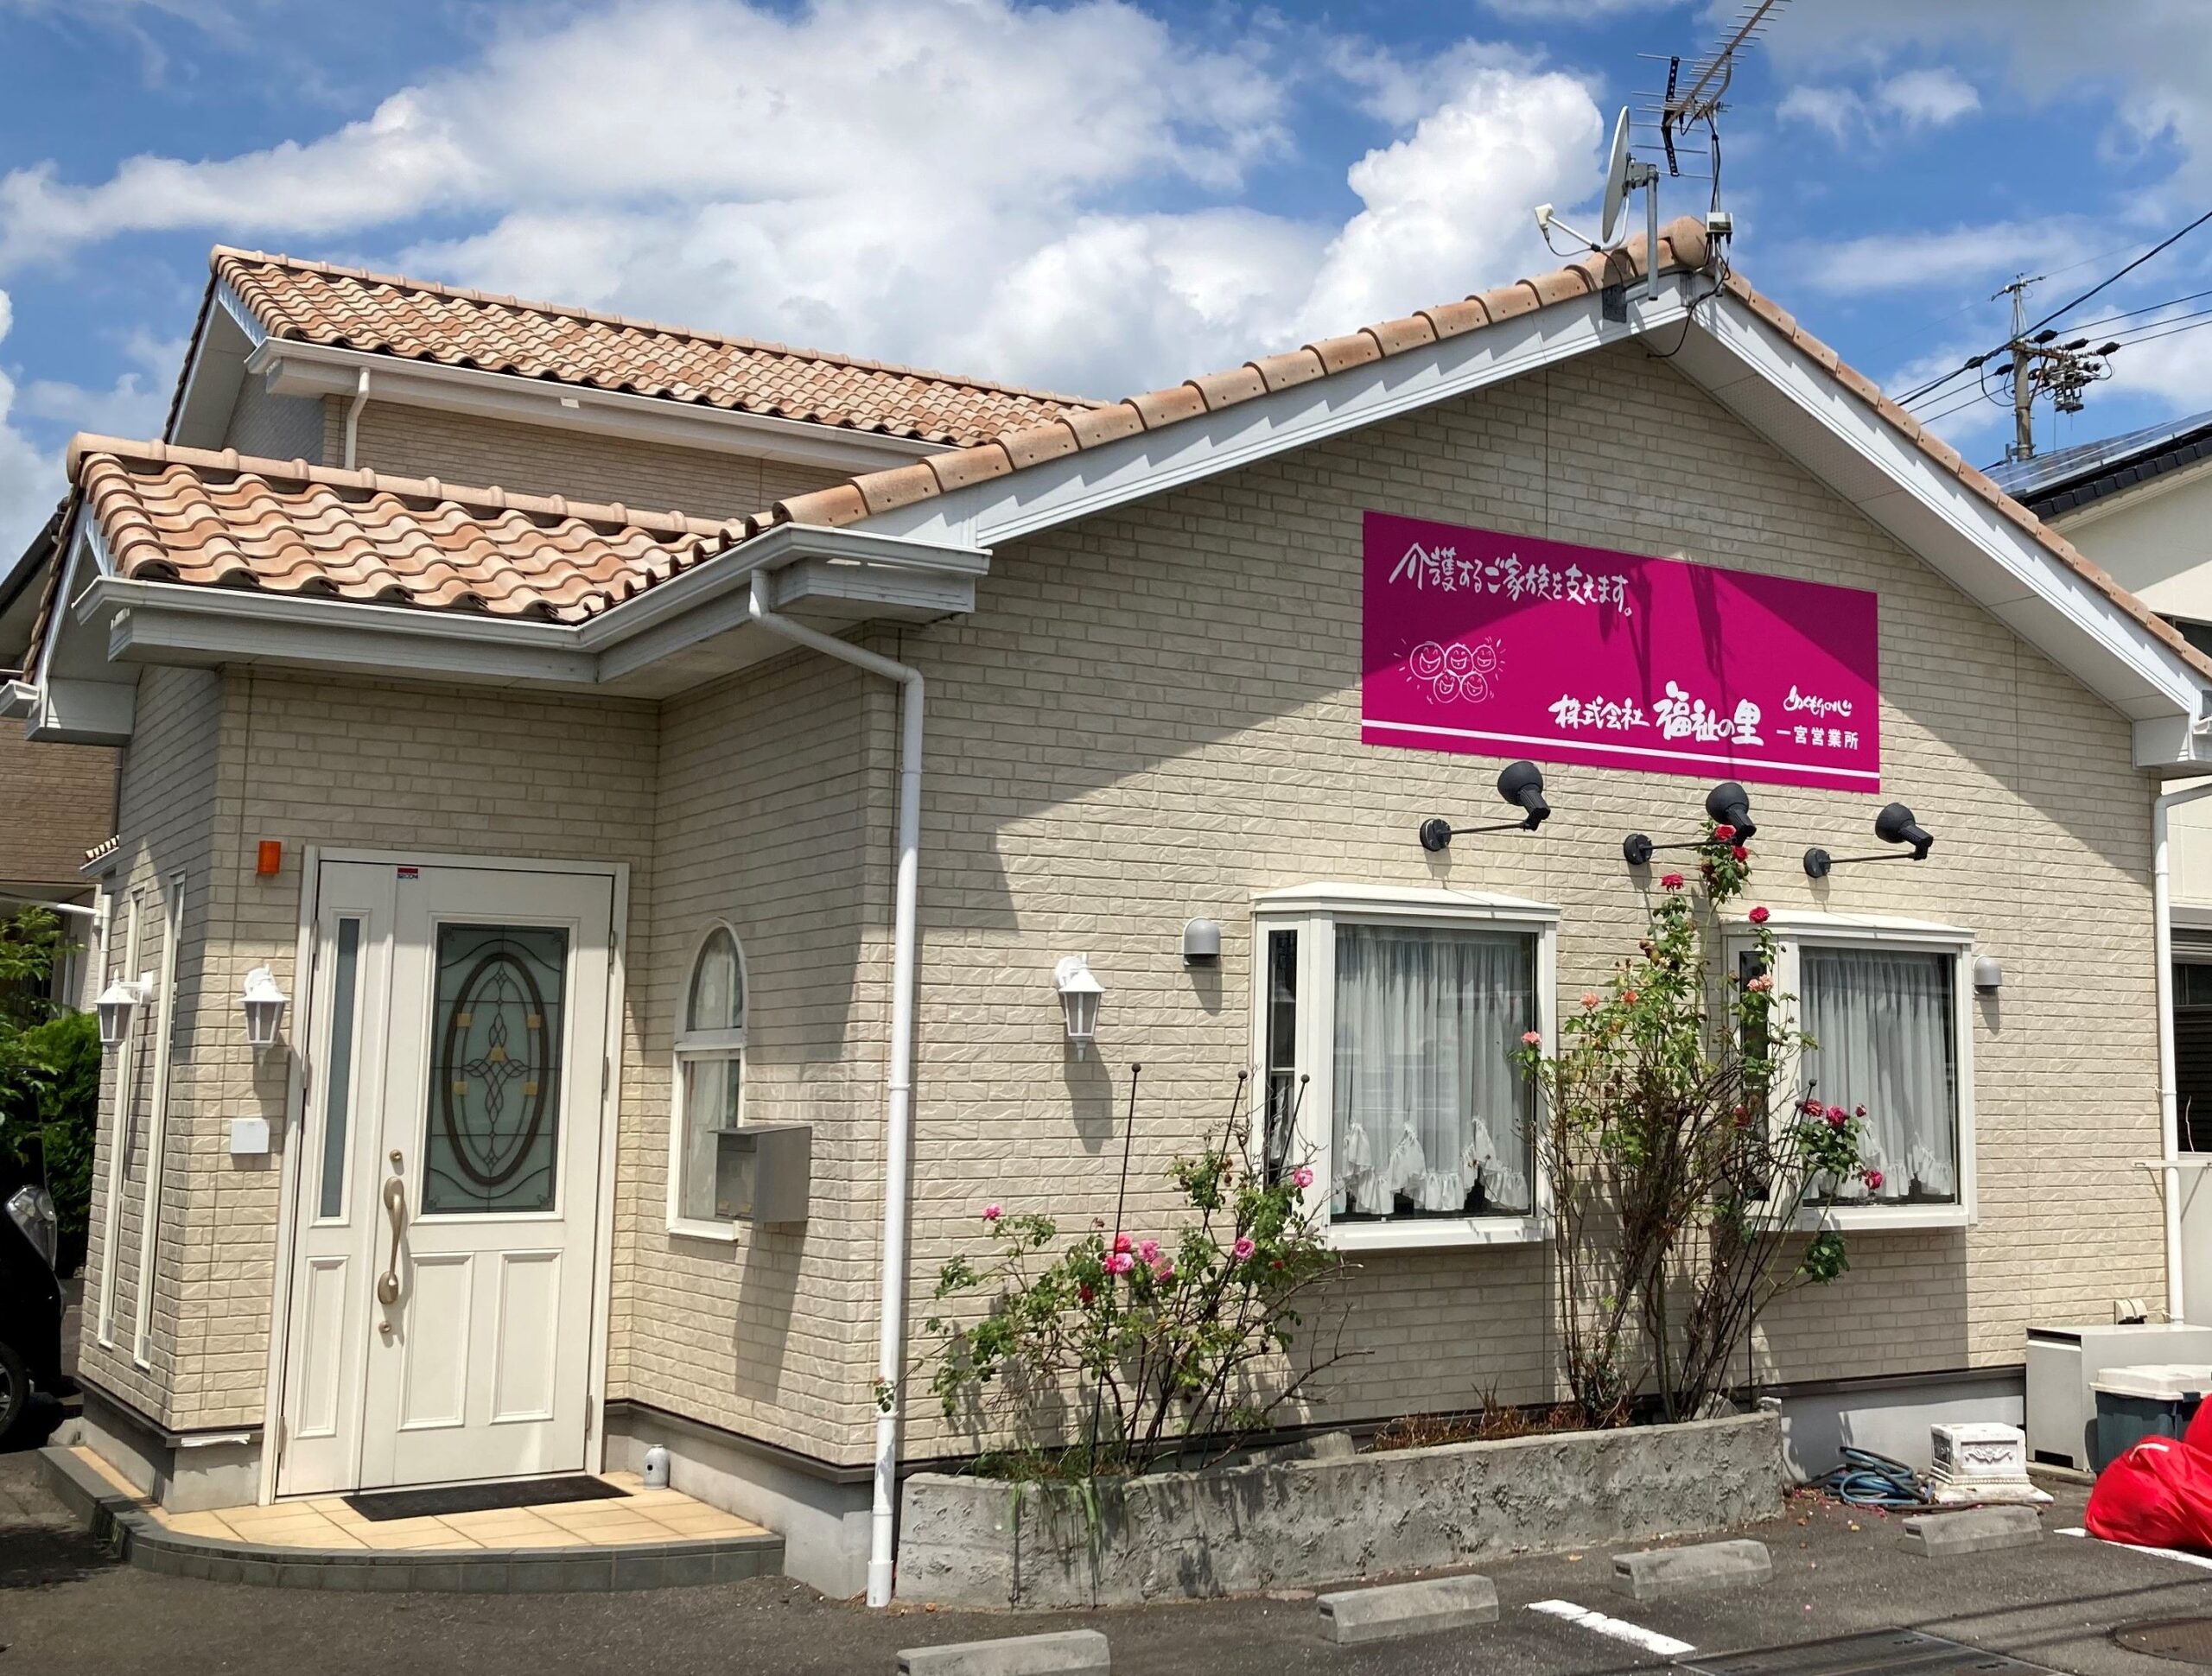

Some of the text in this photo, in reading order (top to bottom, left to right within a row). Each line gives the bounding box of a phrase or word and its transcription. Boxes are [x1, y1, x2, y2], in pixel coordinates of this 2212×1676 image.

[1389, 543, 1632, 616] 介護するご家族を支えます。
[1548, 680, 1764, 746] 株式会社 福祉の里
[1777, 725, 1859, 750] 一宮営業所
